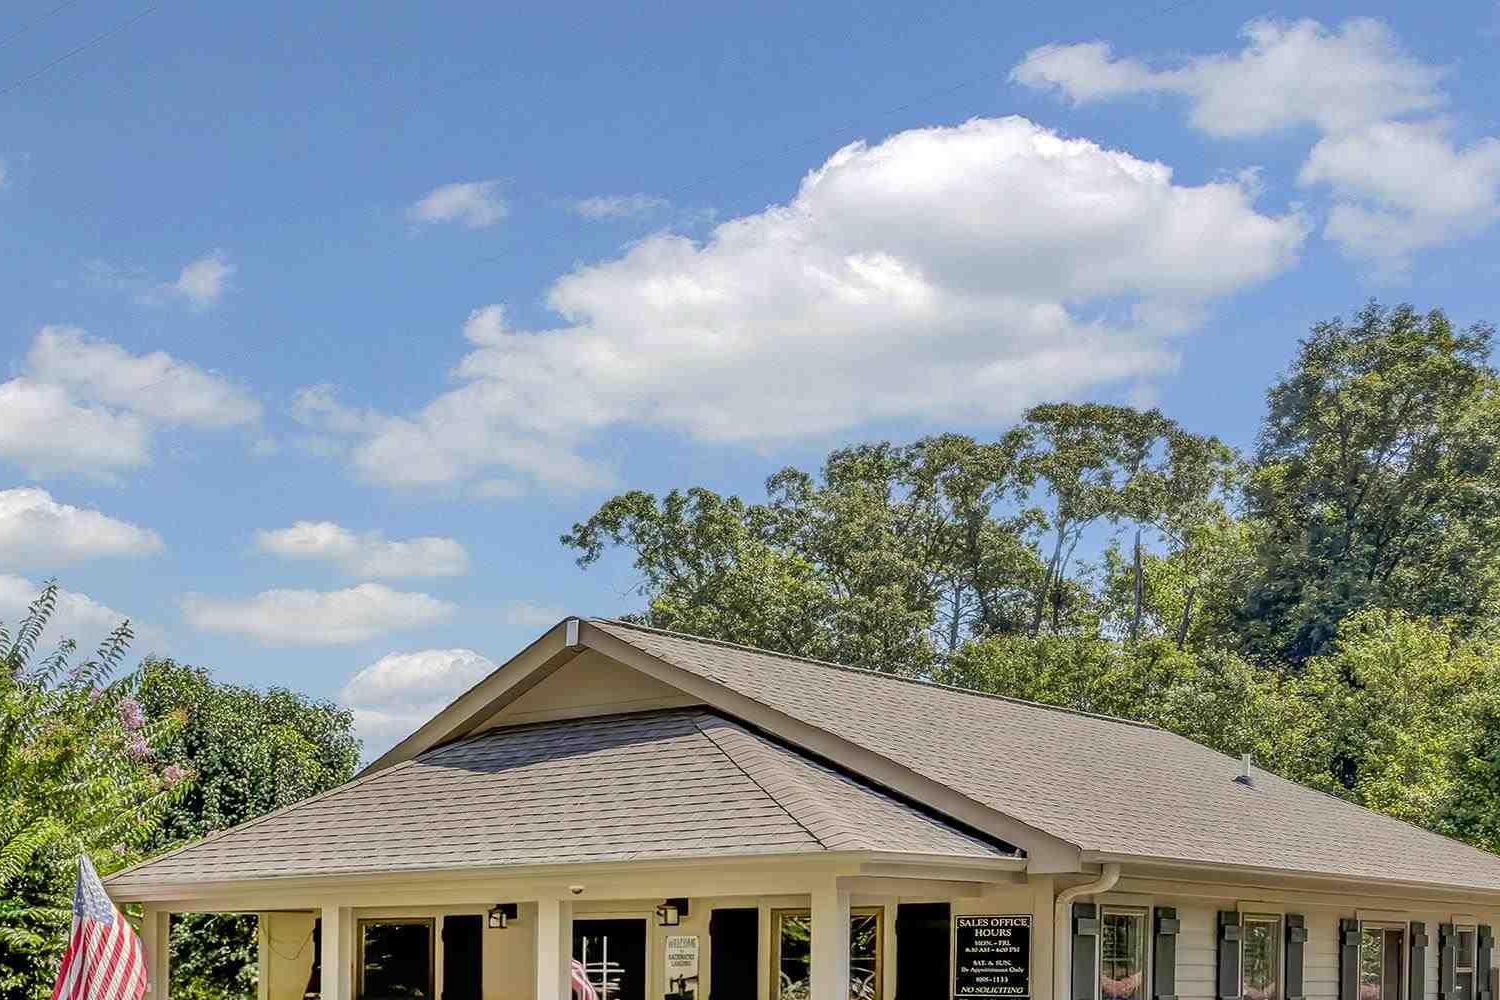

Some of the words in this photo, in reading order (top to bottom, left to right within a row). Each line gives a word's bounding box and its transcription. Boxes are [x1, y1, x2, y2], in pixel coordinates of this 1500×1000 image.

[959, 919, 989, 927] SALES
[990, 918, 1028, 927] OFFICE
[974, 928, 1012, 937] HOURS
[960, 986, 974, 994] NO
[974, 986, 1024, 994] SOLICITING
